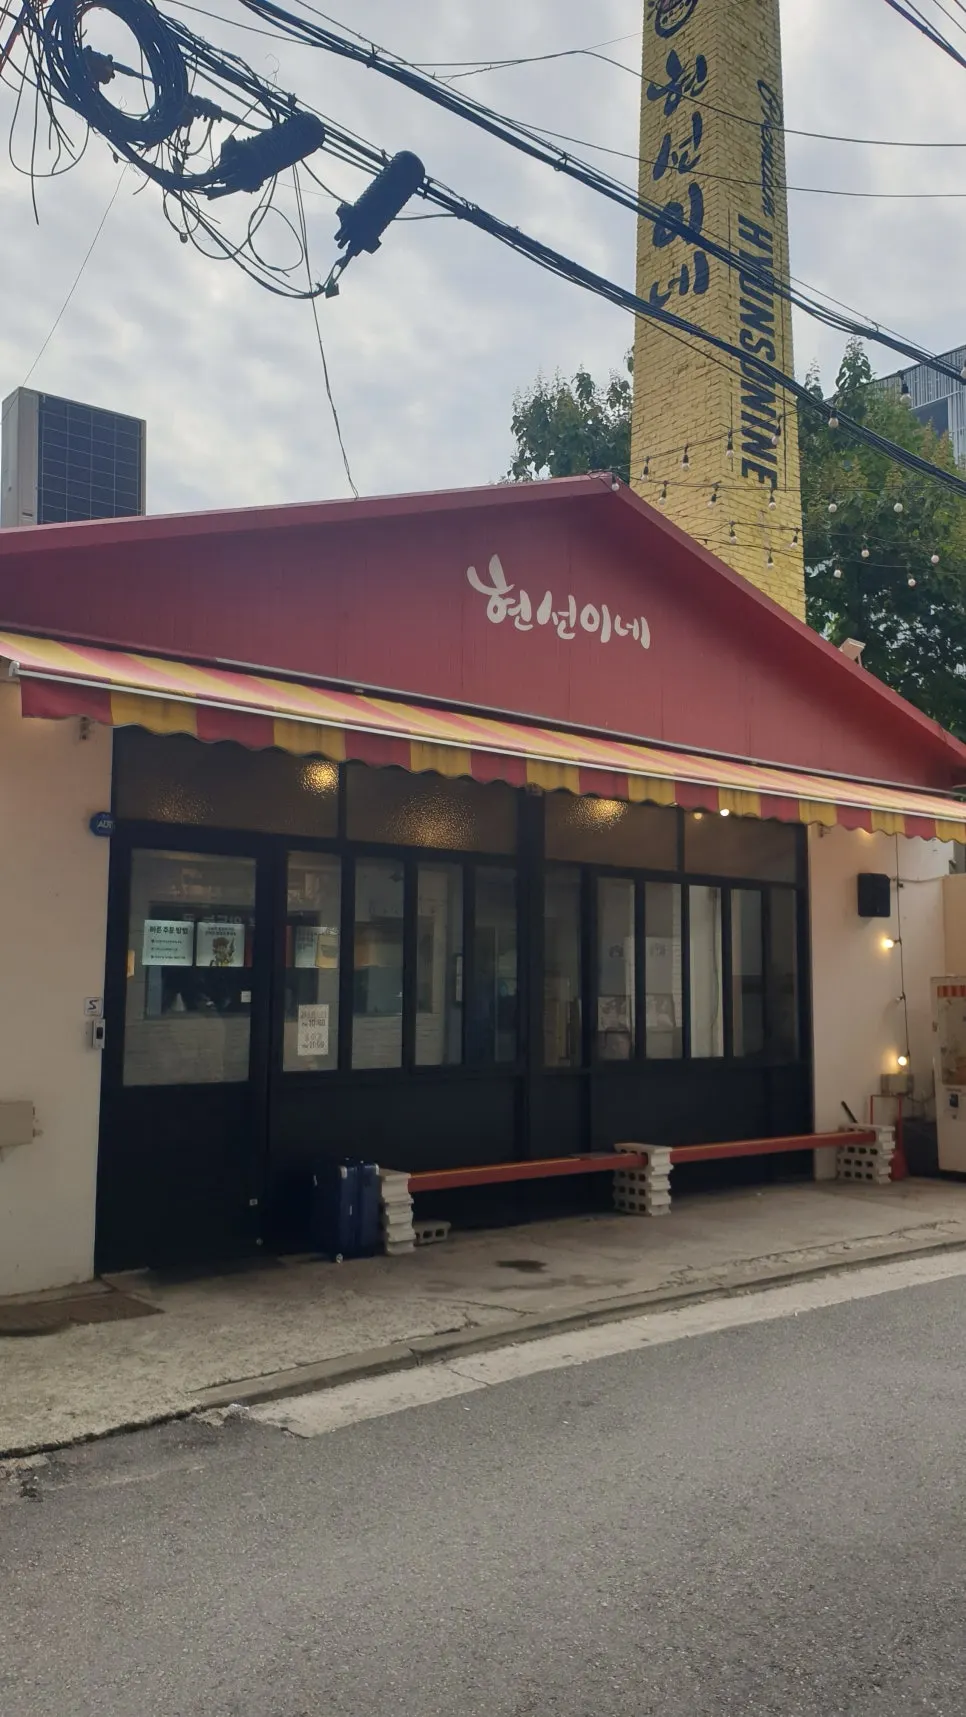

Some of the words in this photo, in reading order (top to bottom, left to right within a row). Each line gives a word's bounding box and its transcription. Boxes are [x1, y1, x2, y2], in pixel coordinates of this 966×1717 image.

[646, 49, 710, 312] 현선이네
[466, 553, 650, 650] 현선이네
[163, 926, 174, 935] 주문
